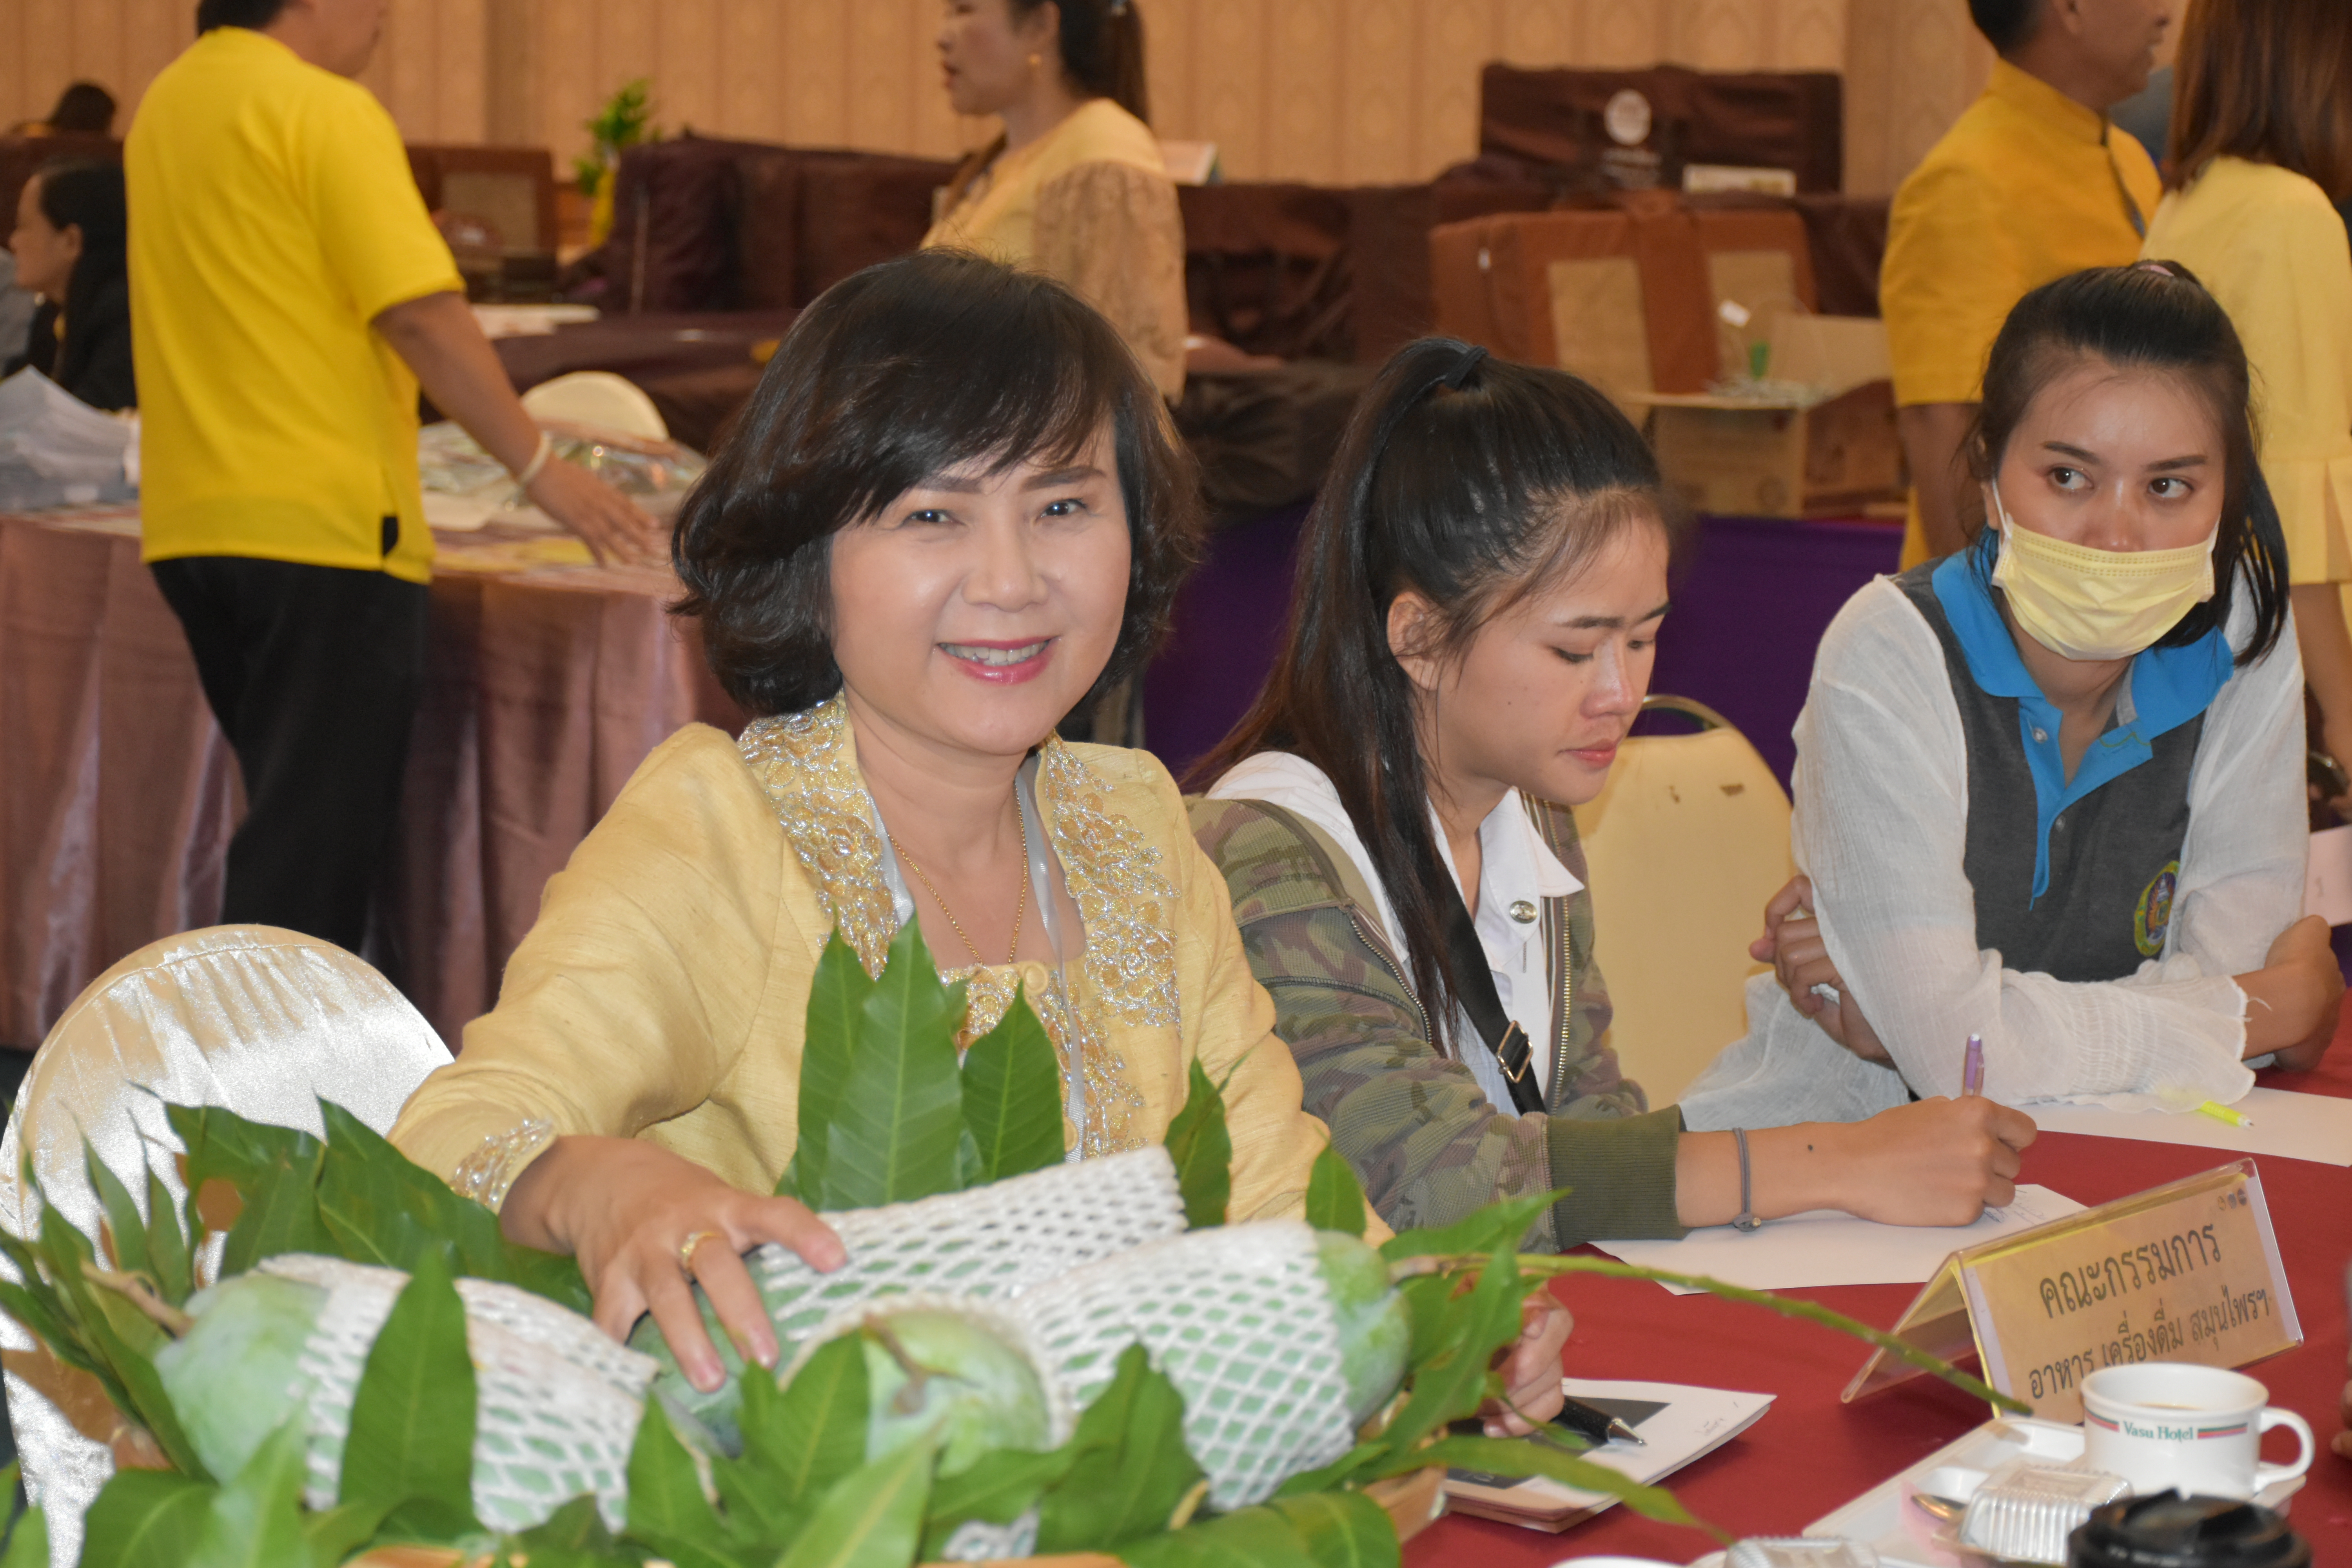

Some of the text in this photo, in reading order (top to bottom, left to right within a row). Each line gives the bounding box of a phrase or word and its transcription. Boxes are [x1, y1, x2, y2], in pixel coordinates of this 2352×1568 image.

[2040, 1224, 2221, 1319] คณะกรรมการ
[2029, 1284, 2269, 1399] อาหาร เครื่องดื่ม สมุนไพรฯ
[2123, 1421, 2194, 1444] Vasu Hotel
